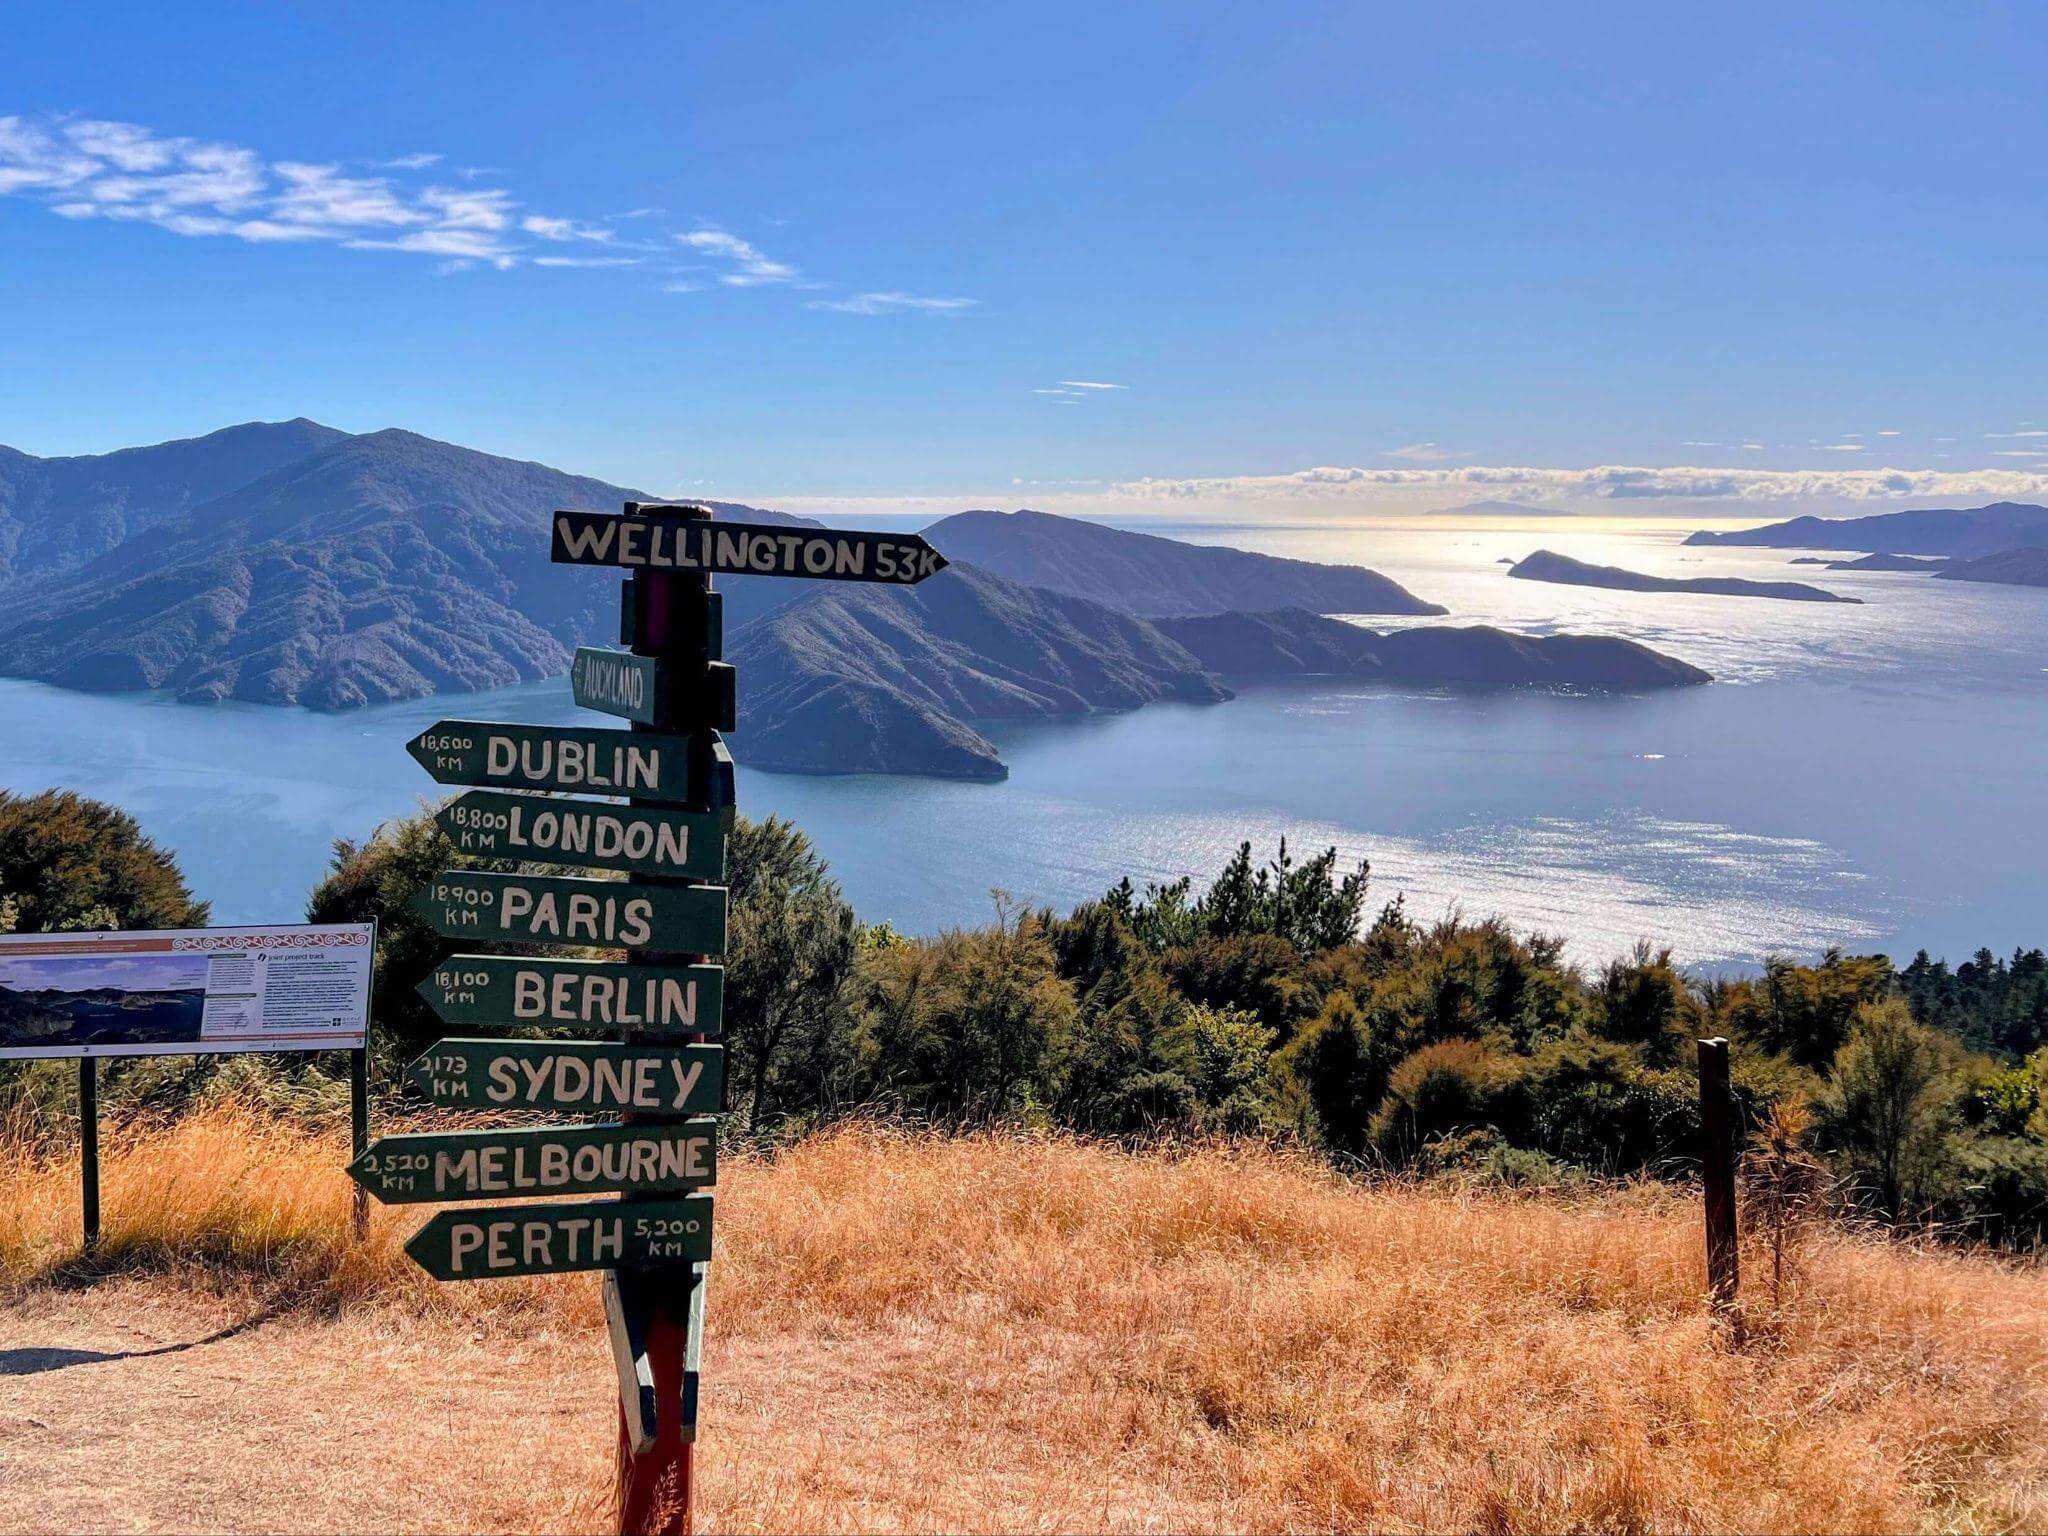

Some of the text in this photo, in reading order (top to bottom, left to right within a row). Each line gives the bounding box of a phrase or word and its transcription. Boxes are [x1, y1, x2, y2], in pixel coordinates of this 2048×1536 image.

[557, 517, 938, 581] WELLINGTON 53K
[583, 655, 643, 710] AUCKLAND
[437, 755, 462, 771] KM
[486, 735, 660, 789] DUBLIN
[449, 806, 508, 829] 18,800
[509, 806, 689, 866] LONDON
[461, 831, 495, 849] KM
[445, 907, 478, 926] KM
[500, 886, 653, 946] PARIS
[285, 953, 308, 961] project
[444, 990, 475, 1004] KM
[513, 970, 697, 1026] BERLIN
[432, 1078, 469, 1098] KM
[485, 1055, 704, 1109] SYDNEY
[381, 1174, 415, 1191] KM
[434, 1137, 710, 1193] MELBOURNE
[450, 1217, 700, 1272] PERTH 5,200
[648, 1241, 682, 1257] KM
